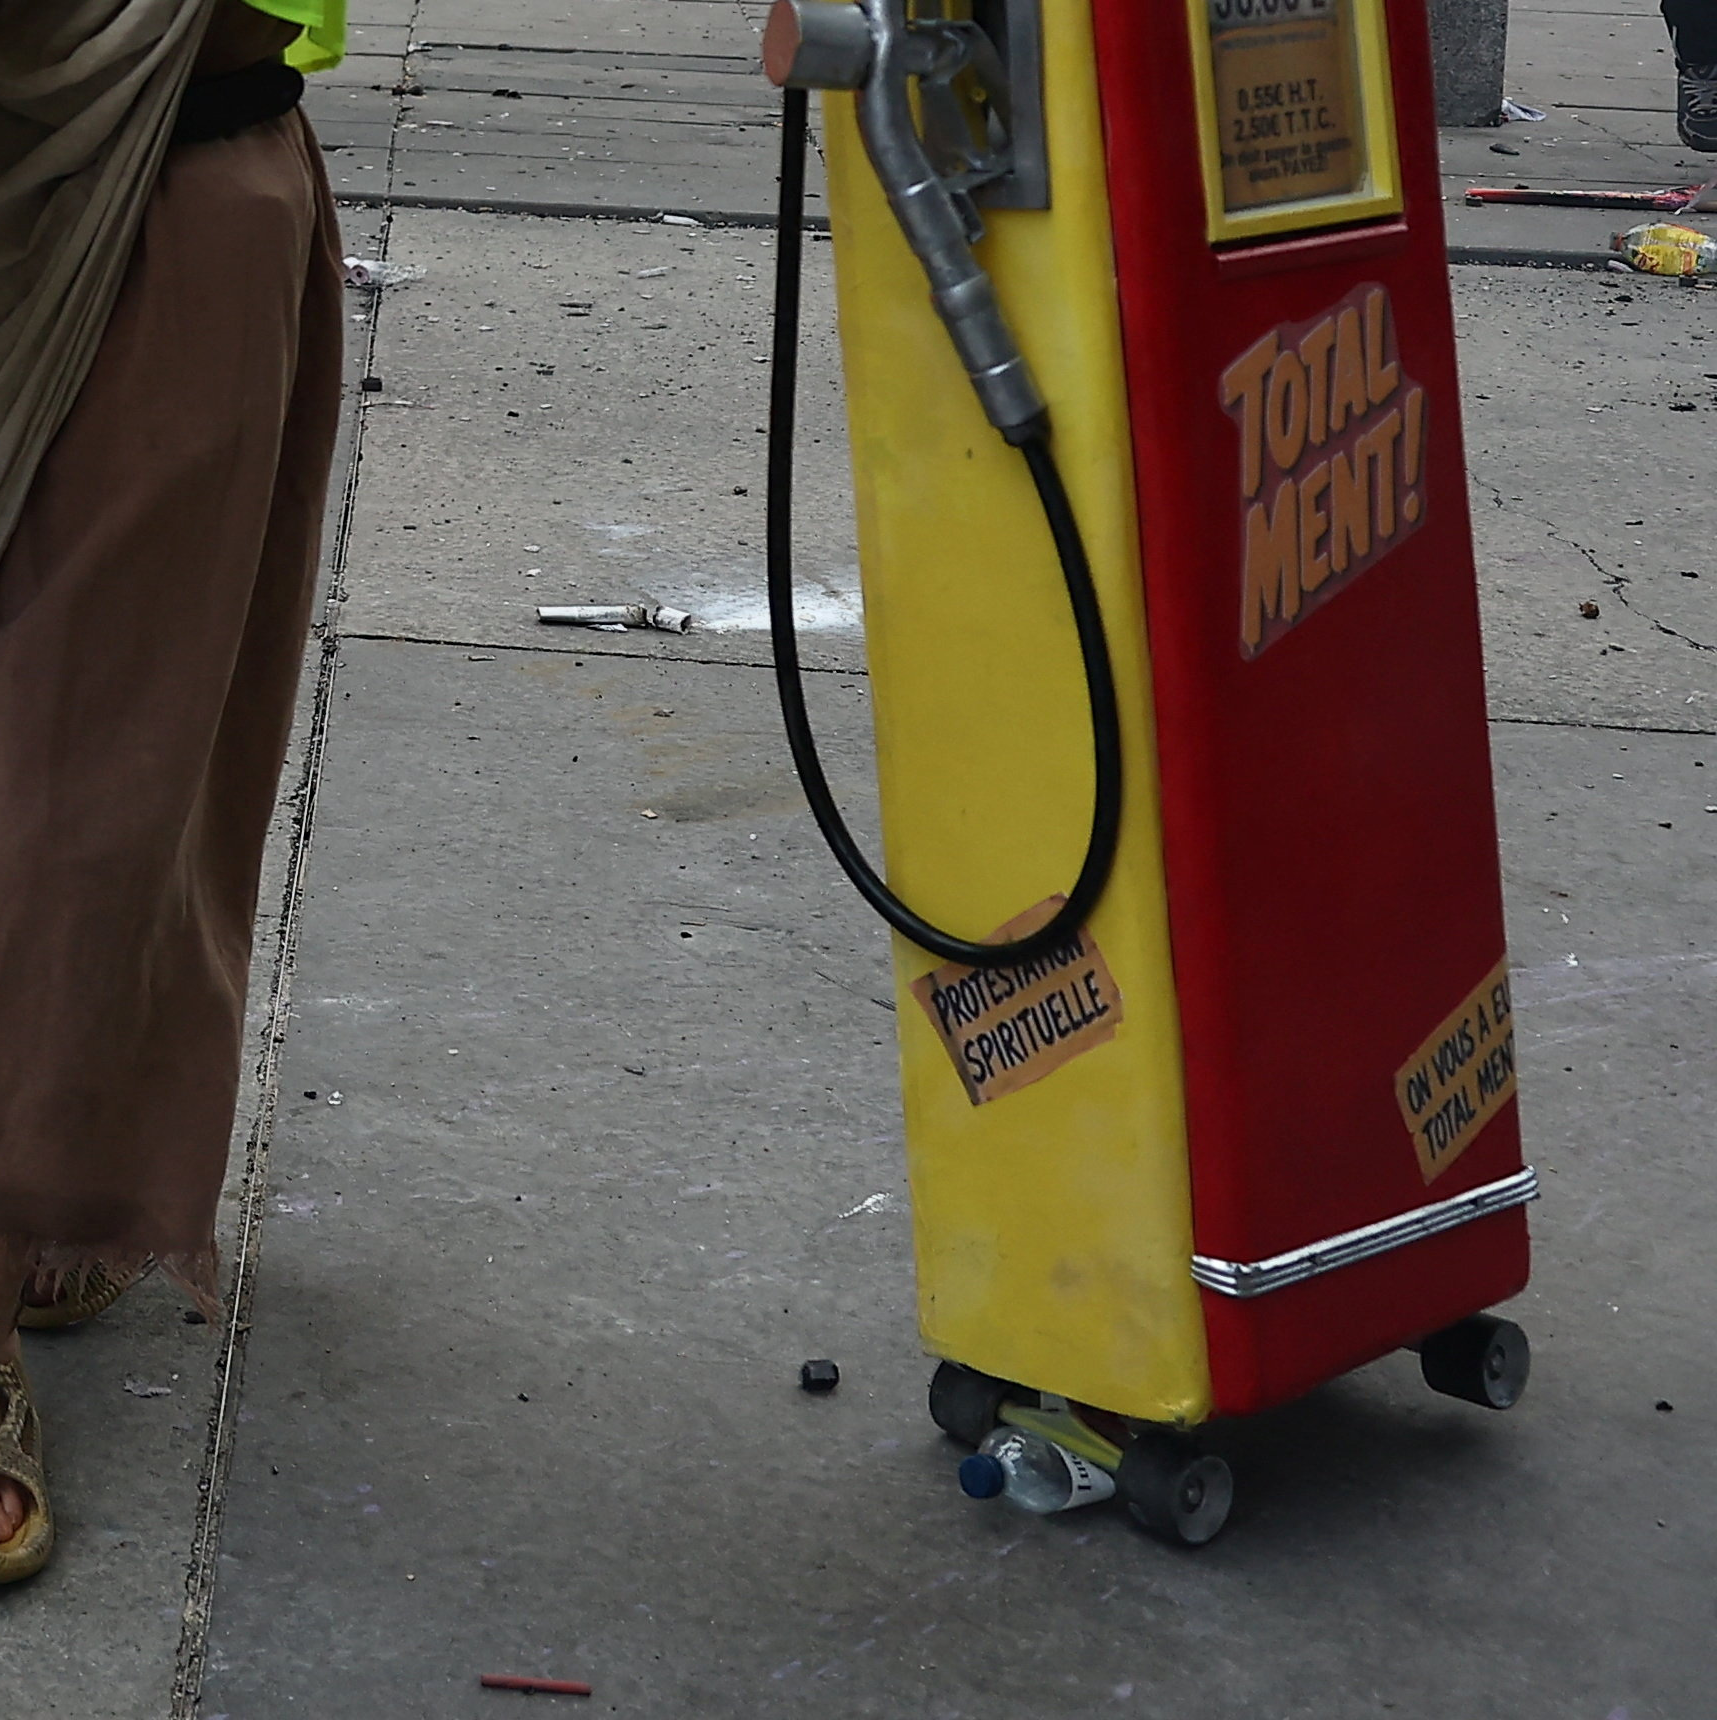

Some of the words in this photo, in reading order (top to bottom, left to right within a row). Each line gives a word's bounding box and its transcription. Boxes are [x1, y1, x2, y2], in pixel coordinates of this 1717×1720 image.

[1222, 288, 1399, 498] TOTAL
[1242, 386, 1423, 653] MENT!
[963, 969, 1111, 1085] SPIRITUELLE
[1407, 1063, 1432, 1115] ON
[1432, 1018, 1476, 1087] VOUS
[1478, 1003, 1491, 1044] A
[1422, 1085, 1477, 1161] TOTAL
